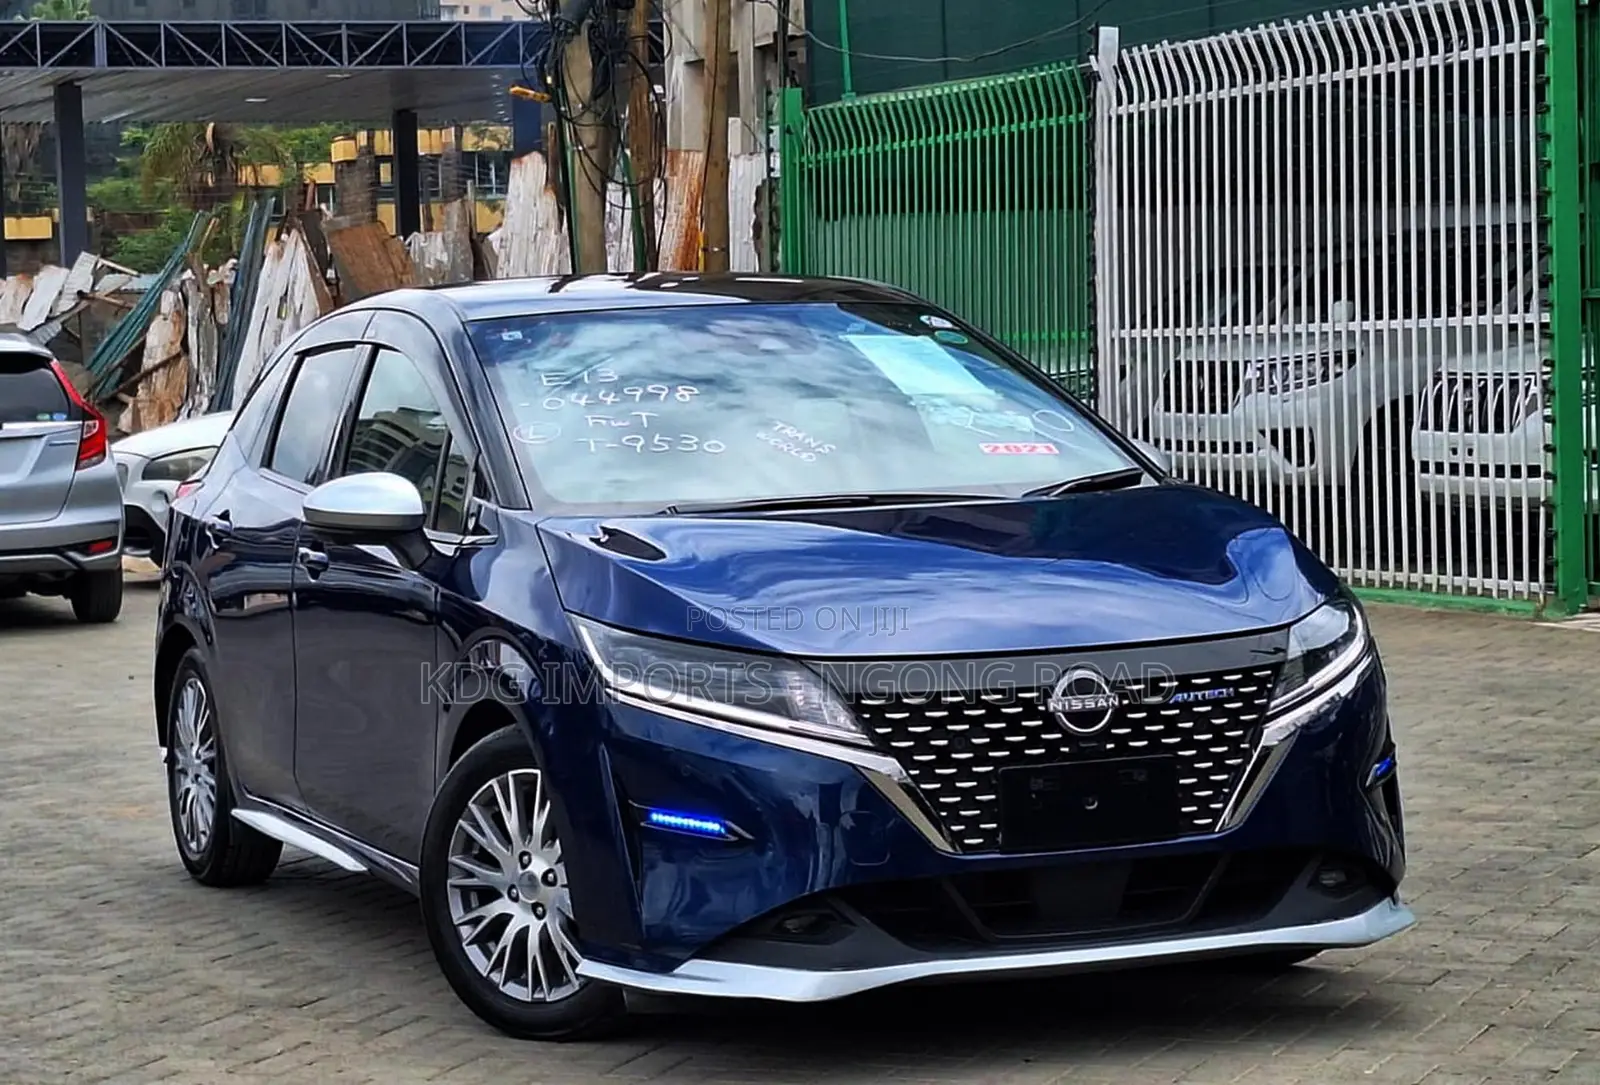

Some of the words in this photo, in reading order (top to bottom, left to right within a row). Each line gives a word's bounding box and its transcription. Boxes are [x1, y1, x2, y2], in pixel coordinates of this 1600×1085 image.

[574, 433, 726, 453] T-9530
[983, 443, 1056, 453] 2021
[1049, 694, 1119, 711] NISSAN
[1169, 687, 1235, 704] AUTECH
